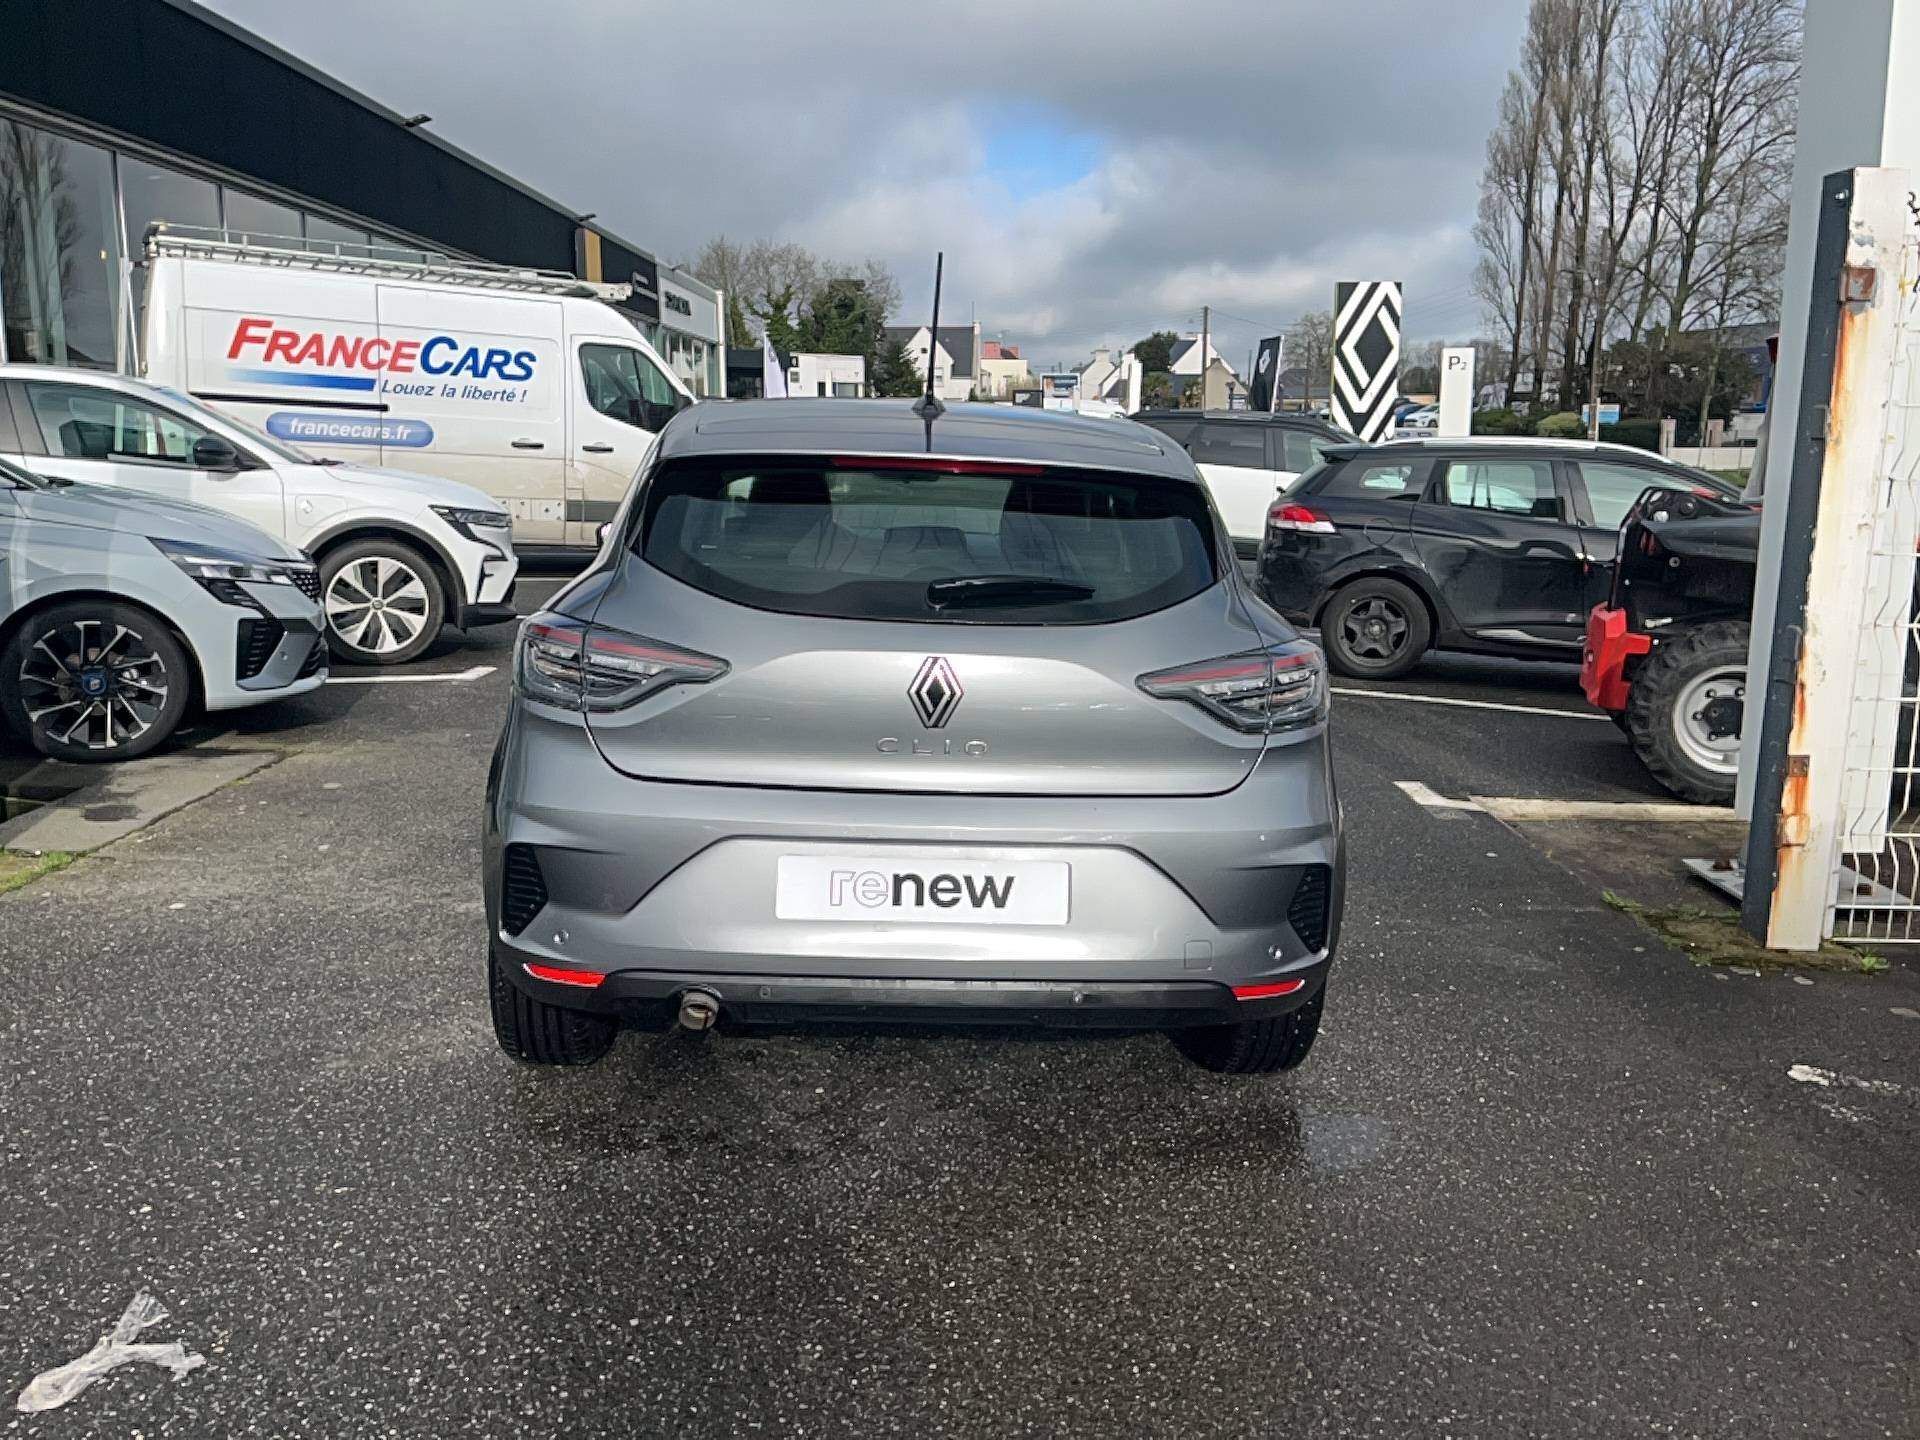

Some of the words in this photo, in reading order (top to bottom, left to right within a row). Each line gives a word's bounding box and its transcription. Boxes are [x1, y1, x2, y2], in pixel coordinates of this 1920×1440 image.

[381, 379, 435, 397] Louez
[440, 383, 457, 399] la
[290, 418, 412, 440] francecars.fr
[876, 737, 988, 756] CLIO
[829, 869, 1016, 909] renew
